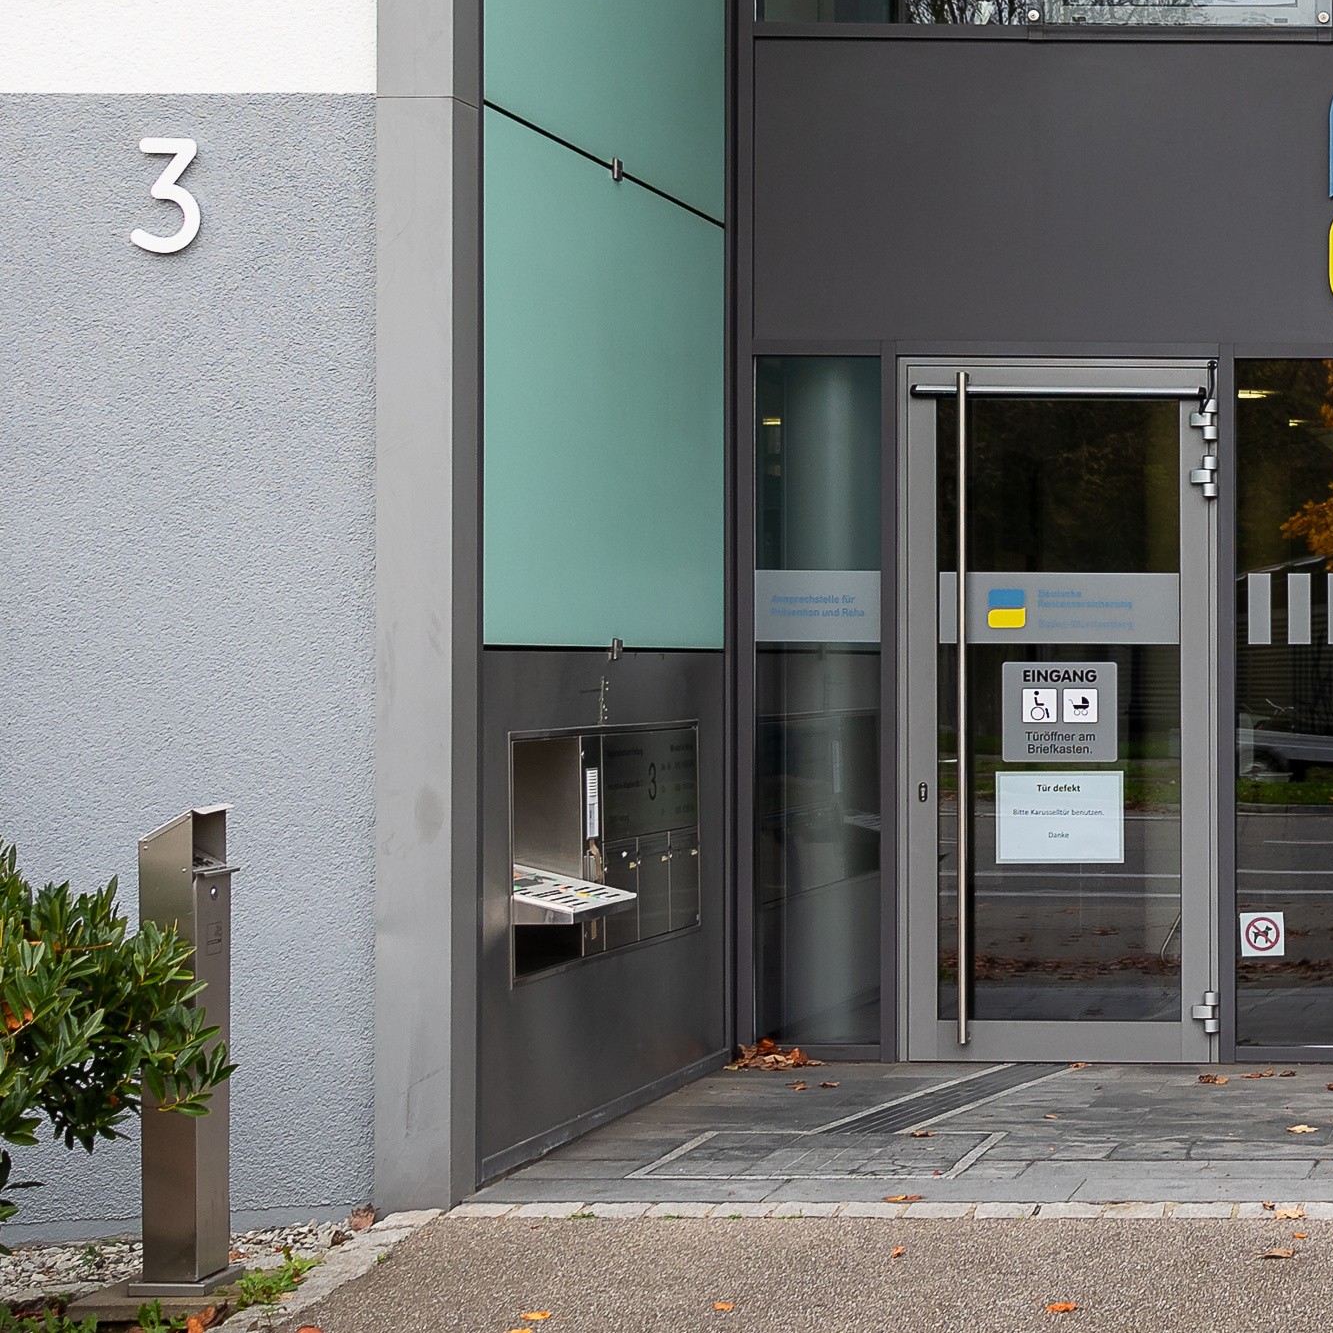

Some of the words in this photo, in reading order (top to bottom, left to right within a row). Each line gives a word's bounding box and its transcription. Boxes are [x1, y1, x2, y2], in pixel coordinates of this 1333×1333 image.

[130, 137, 201, 254] 3
[771, 594, 839, 605] Ansprechstelle
[841, 594, 855, 604] für
[822, 607, 840, 617] und
[841, 607, 865, 617] Reha
[1022, 669, 1098, 683] EINGANG
[1025, 731, 1076, 742] Türöffner
[1078, 732, 1096, 742] am
[1027, 743, 1093, 755] Briefkasten.
[1036, 783, 1051, 793] Tür
[1052, 783, 1081, 793] defekt
[1012, 808, 1029, 817] Bitte
[1030, 808, 1070, 817] Karusselltür
[1071, 808, 1104, 817] benutzen.
[1048, 830, 1070, 839] Danke
